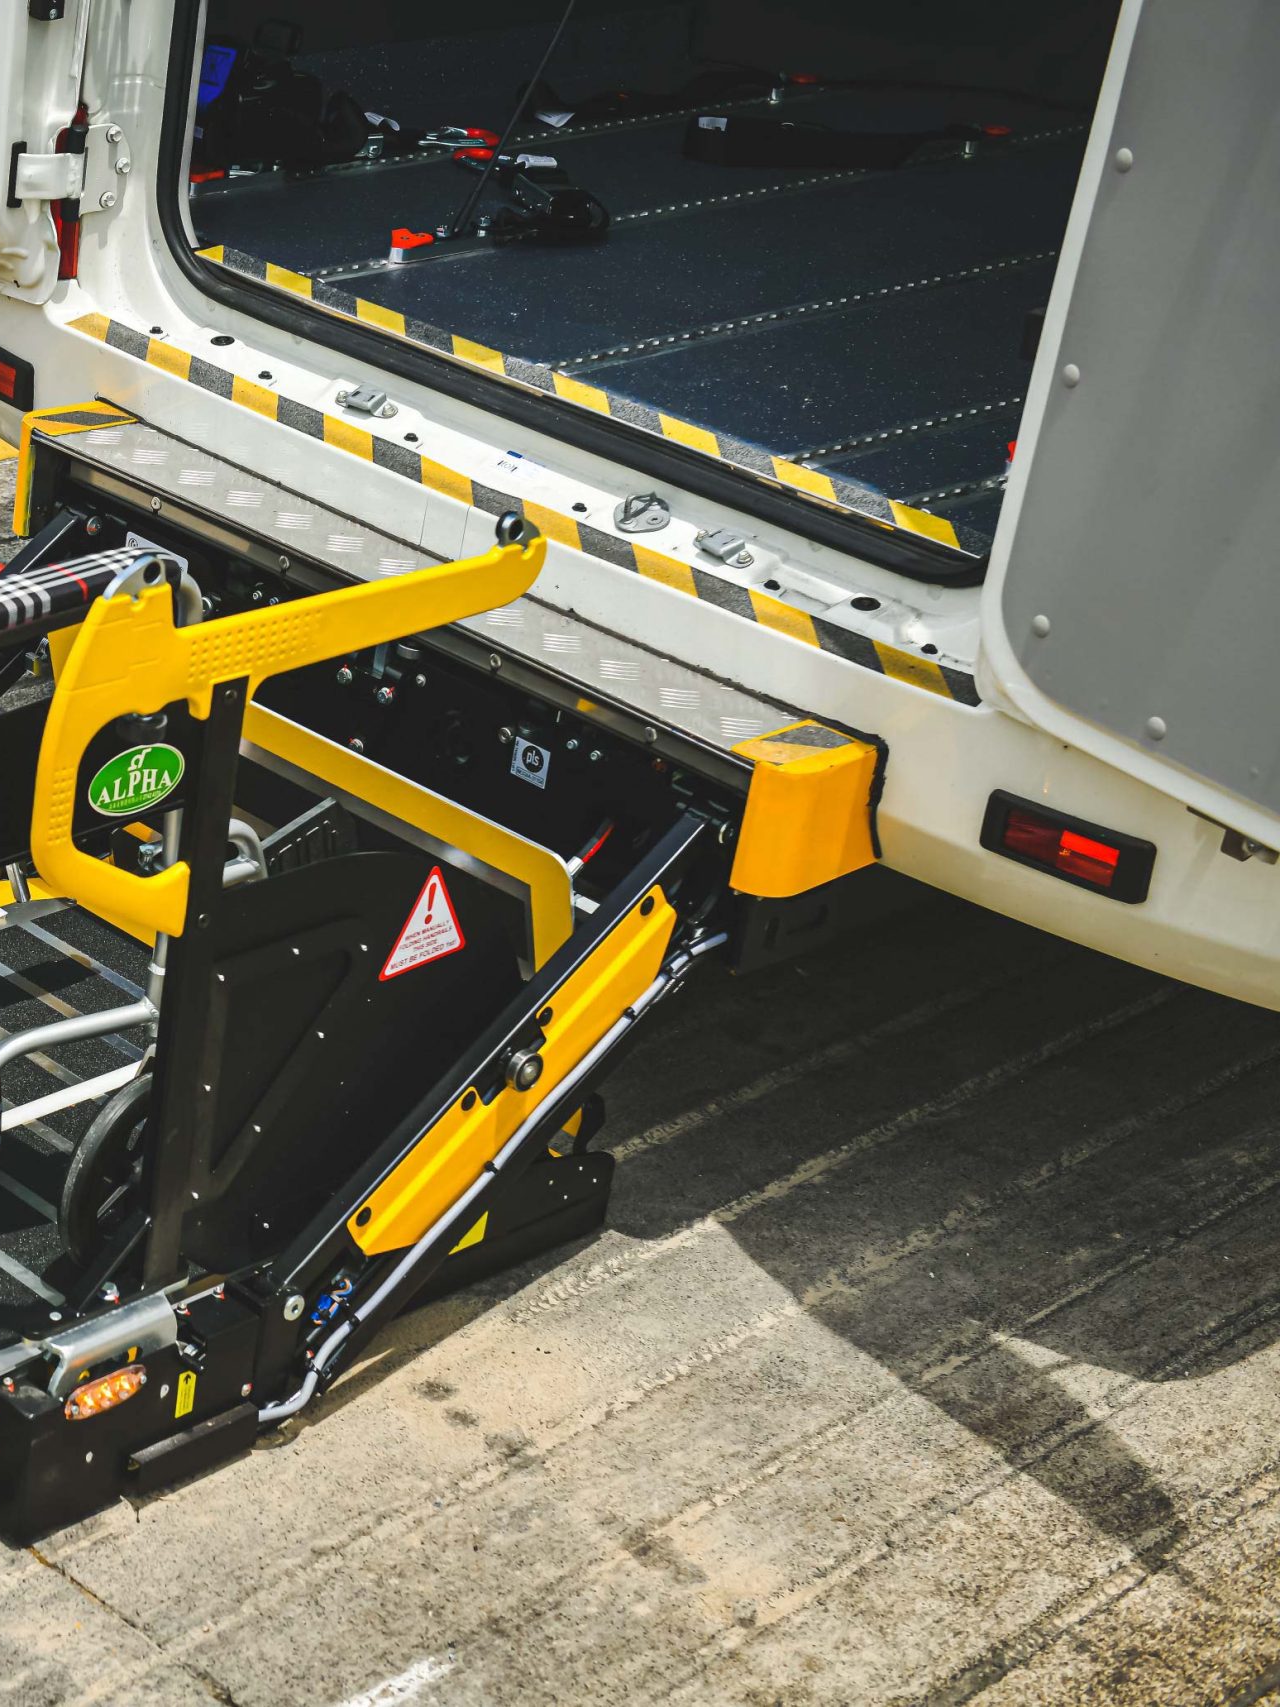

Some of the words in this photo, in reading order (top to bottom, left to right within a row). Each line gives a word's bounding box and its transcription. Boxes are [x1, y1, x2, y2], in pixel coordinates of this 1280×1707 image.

[95, 768, 174, 807] ALPHA
[399, 937, 422, 950] FOLDING
[422, 926, 452, 941] HANDRAILS
[405, 931, 421, 941] WHEN
[422, 920, 450, 934] MANUALLY
[390, 957, 409, 970] MUST
[409, 953, 419, 963] BE
[419, 943, 445, 959] FOLDED
[413, 943, 425, 952] THIS
[425, 938, 438, 948] SIDE
